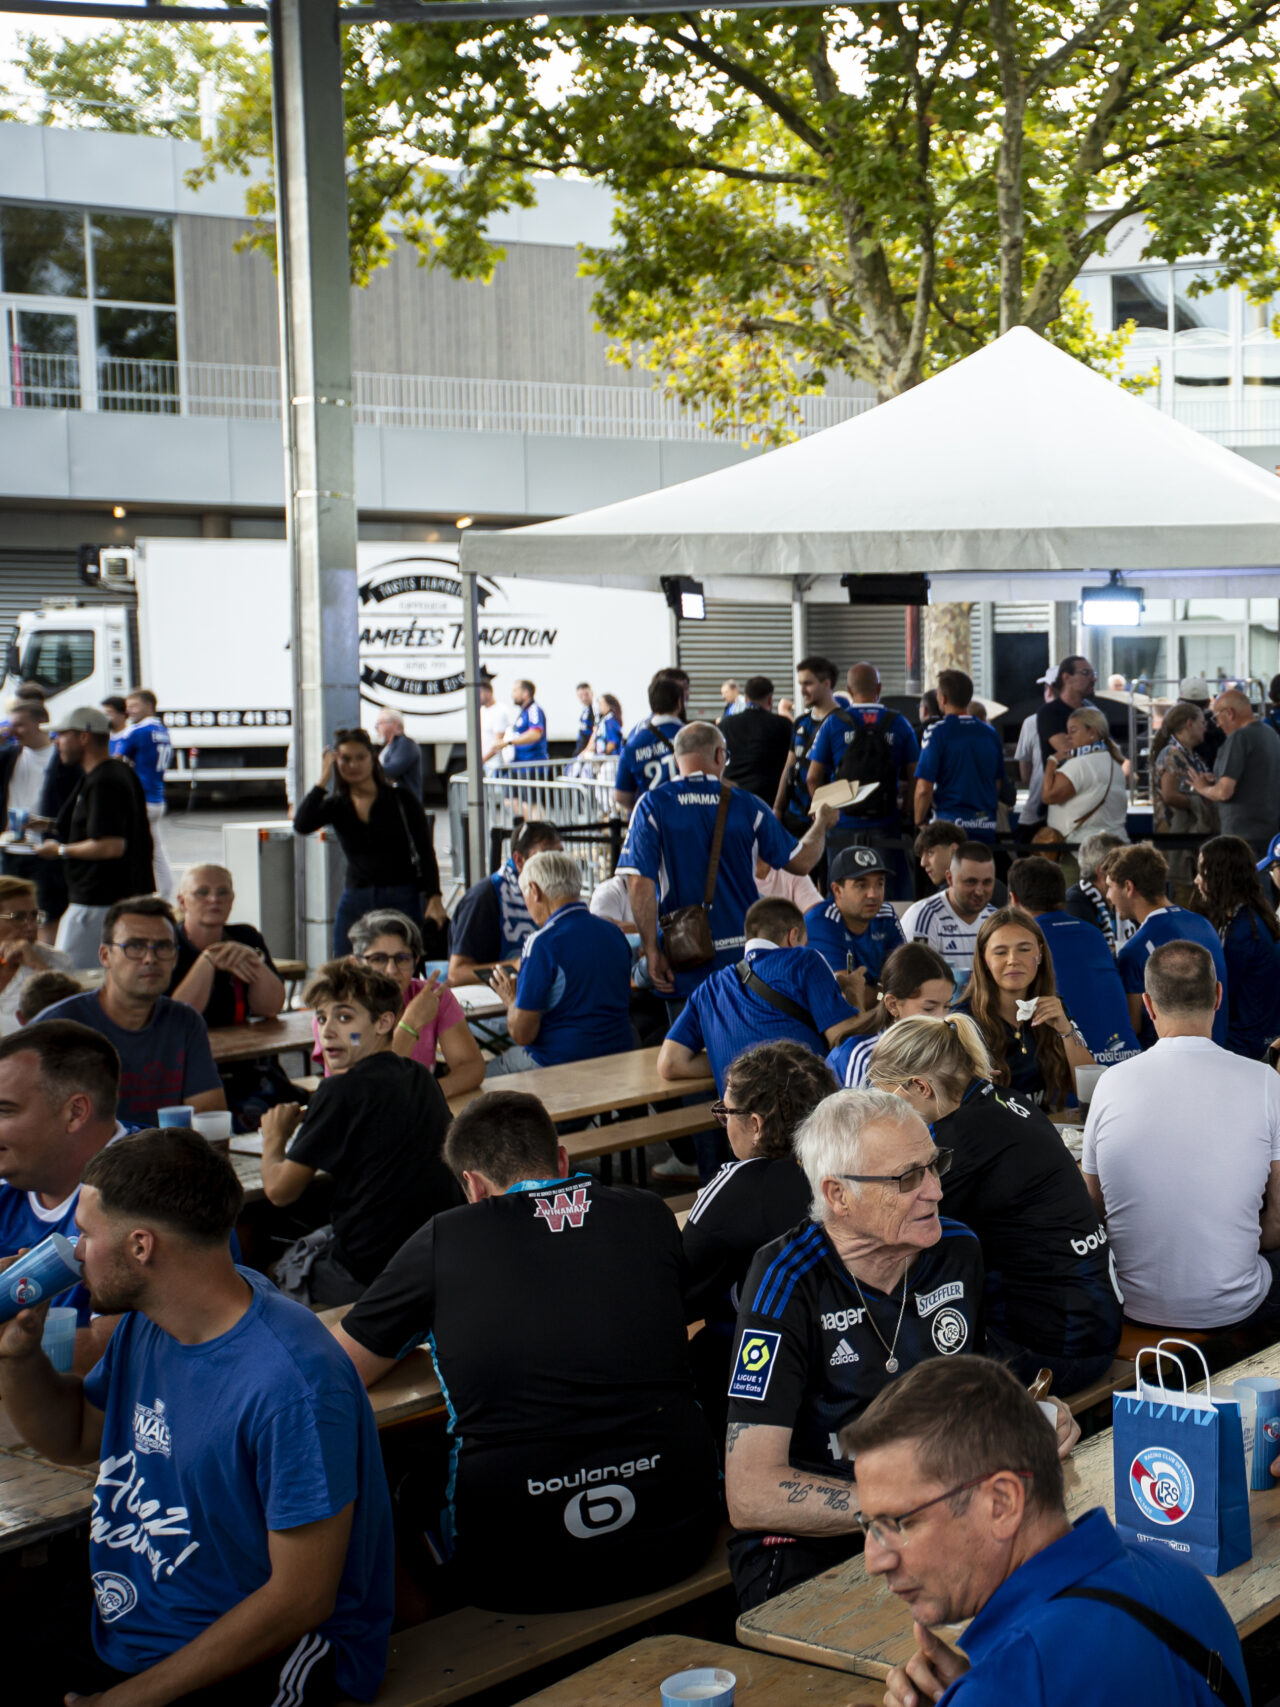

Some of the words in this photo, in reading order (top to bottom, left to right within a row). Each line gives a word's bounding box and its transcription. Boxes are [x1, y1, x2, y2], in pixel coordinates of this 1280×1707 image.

[359, 617, 444, 649] AMBÉES
[449, 623, 557, 650] TADITION
[542, 1203, 586, 1216] WINAMAX
[829, 1353, 860, 1366] adidas
[737, 1374, 757, 1383] LIGUE
[758, 1375, 762, 1384] 1
[733, 1382, 746, 1391] Uber
[745, 1384, 761, 1393] Eats
[527, 1453, 661, 1496] boulanger
